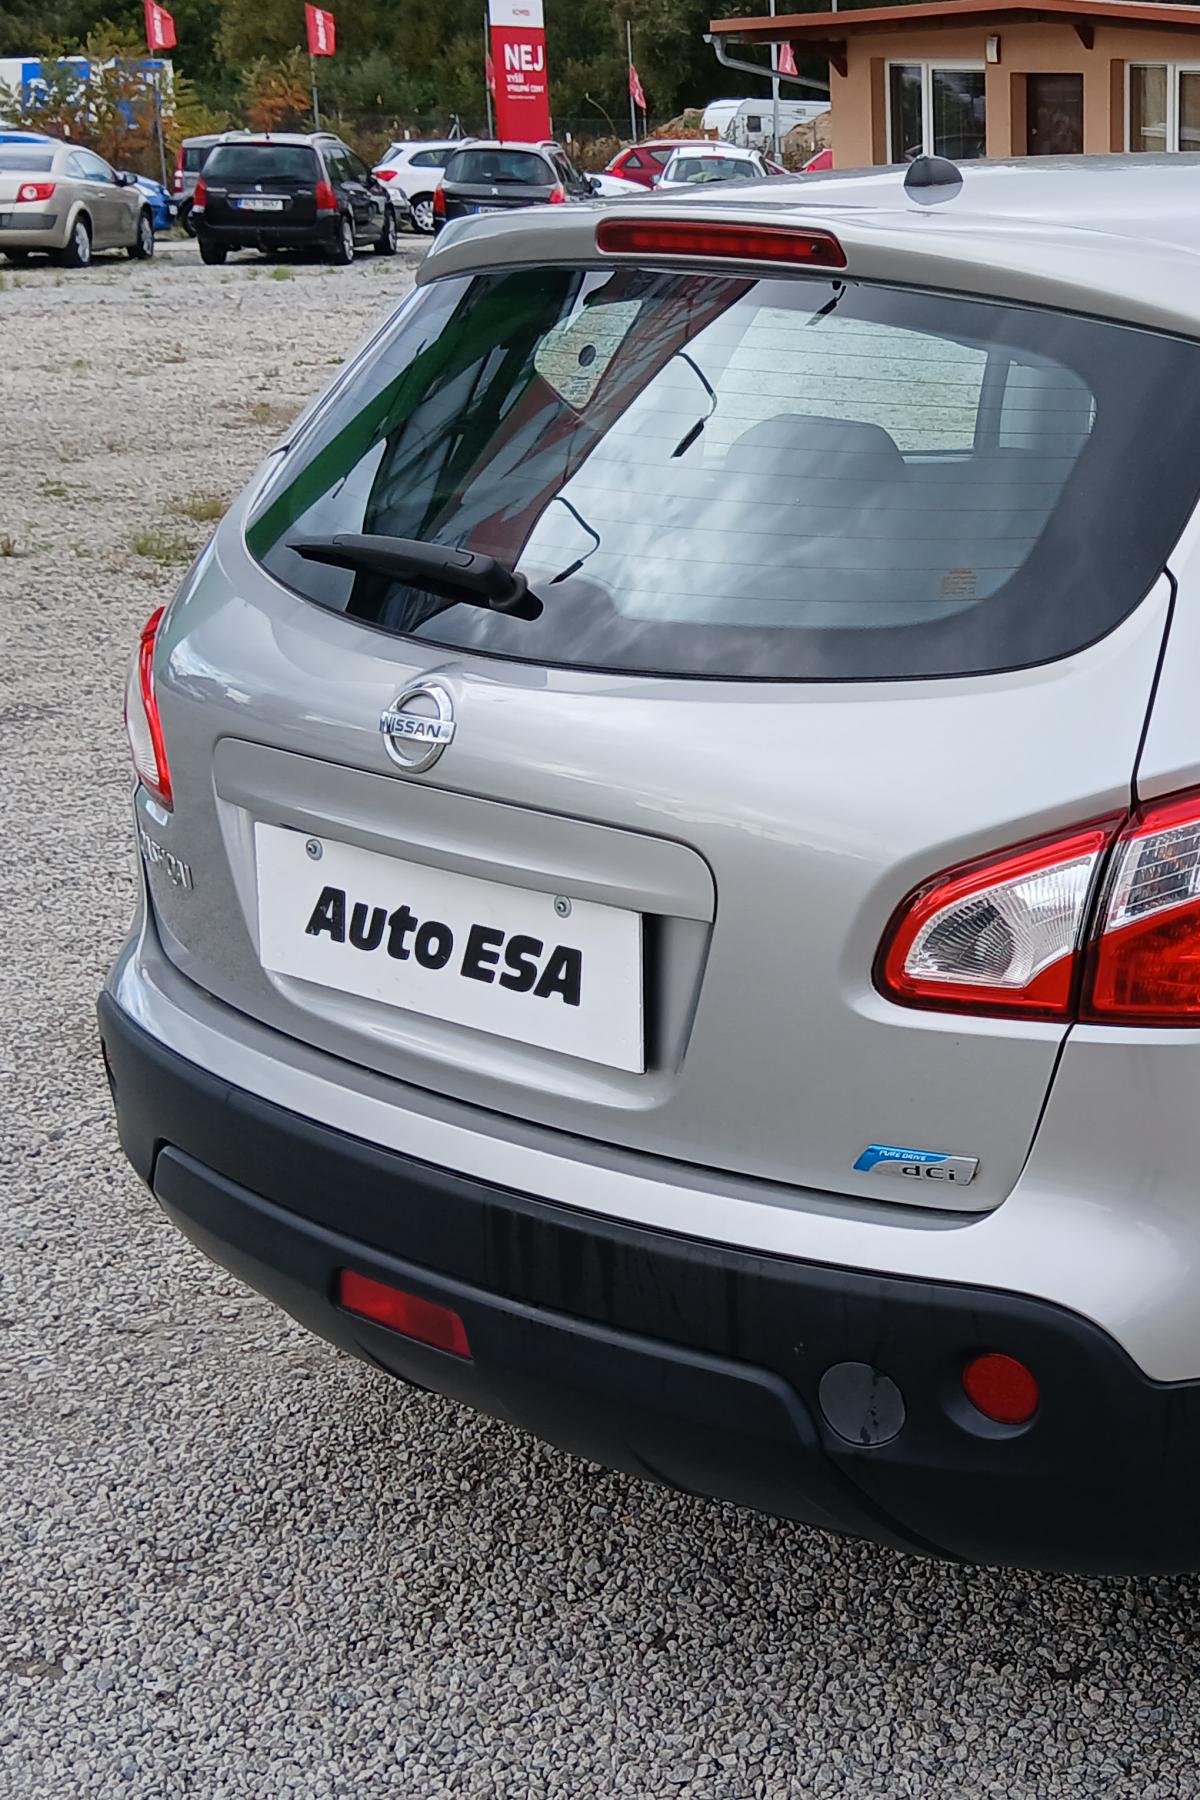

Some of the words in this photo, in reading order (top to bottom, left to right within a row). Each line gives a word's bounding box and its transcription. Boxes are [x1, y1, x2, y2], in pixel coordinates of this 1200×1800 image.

[503, 43, 544, 72] NEJ
[380, 714, 441, 738] NISSAN
[305, 886, 454, 970] Auto
[460, 923, 582, 1007] ESA
